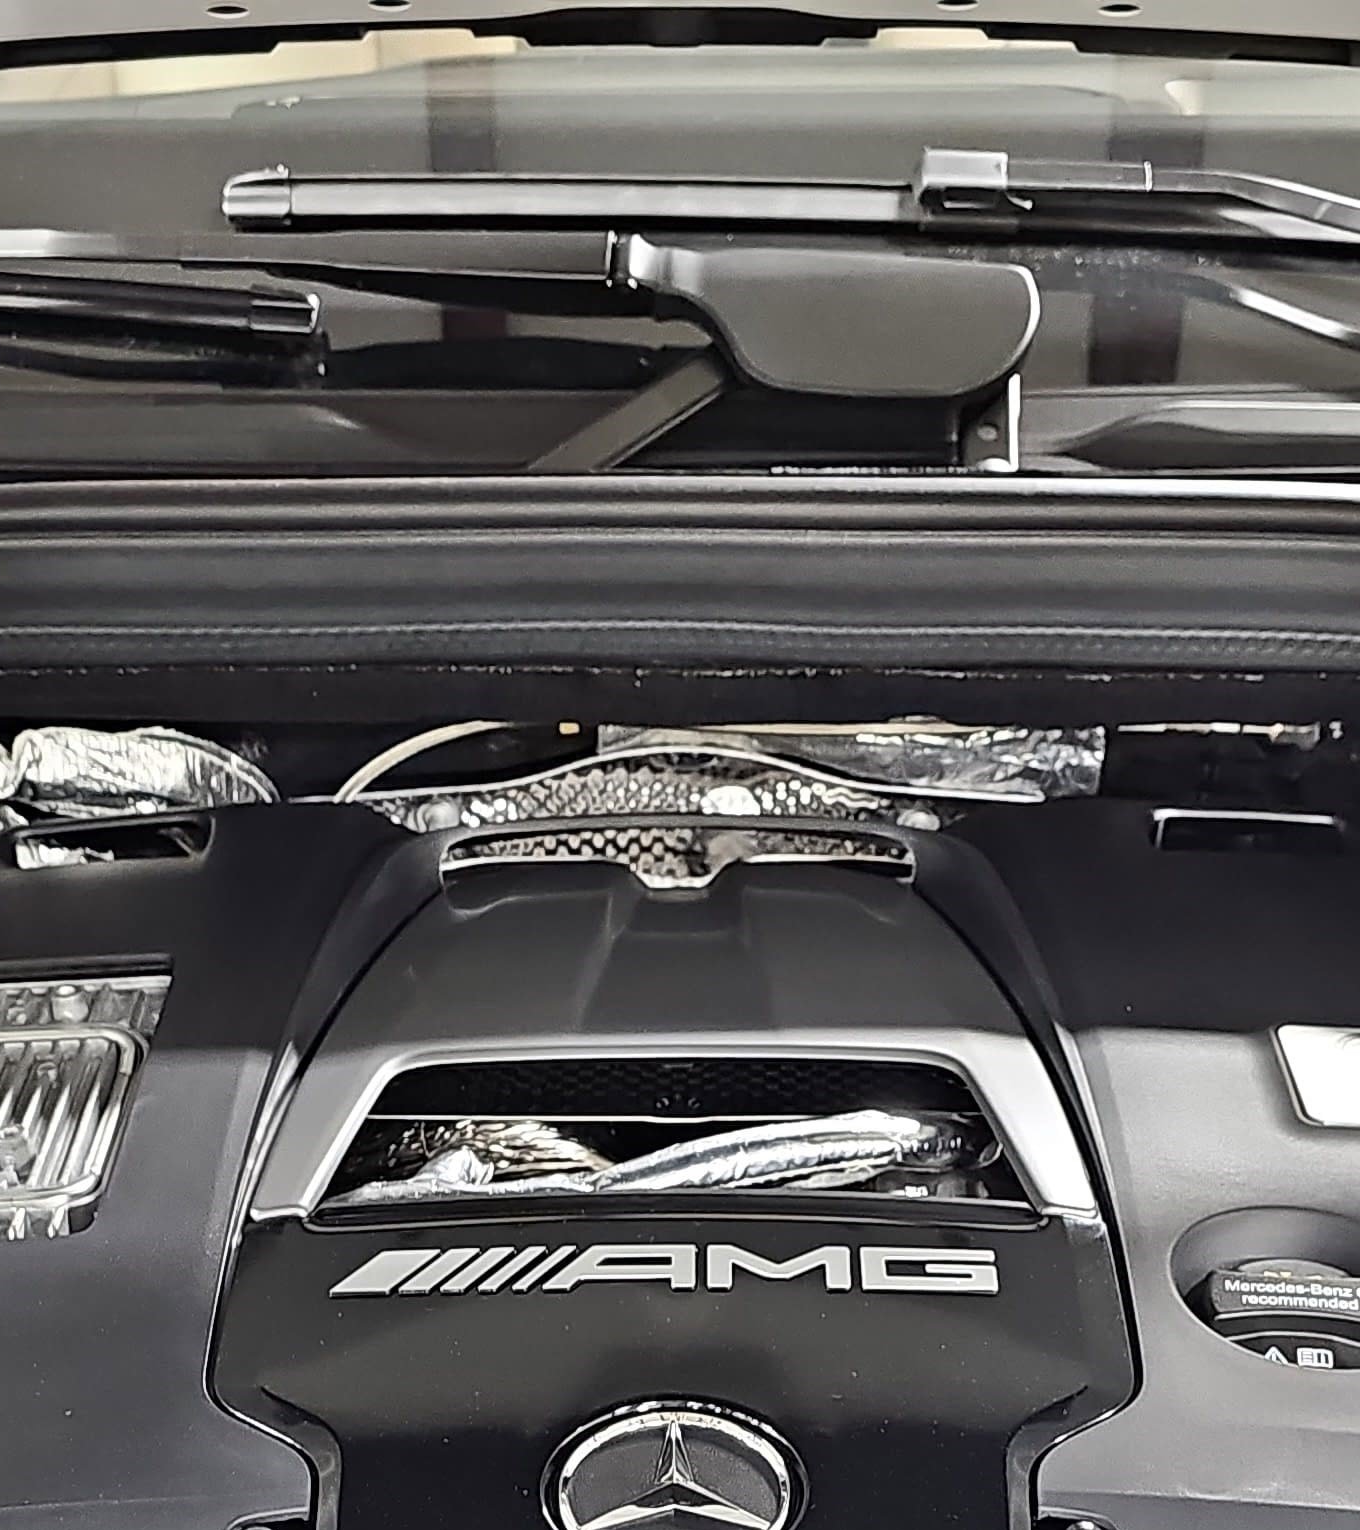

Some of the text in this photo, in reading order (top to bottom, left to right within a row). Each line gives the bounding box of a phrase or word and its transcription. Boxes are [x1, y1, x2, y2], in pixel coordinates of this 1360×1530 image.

[562, 1243, 1000, 1293] AMG
[1224, 1279, 1352, 1297] Mercedes-Benz
[1242, 1294, 1359, 1310] recommended
